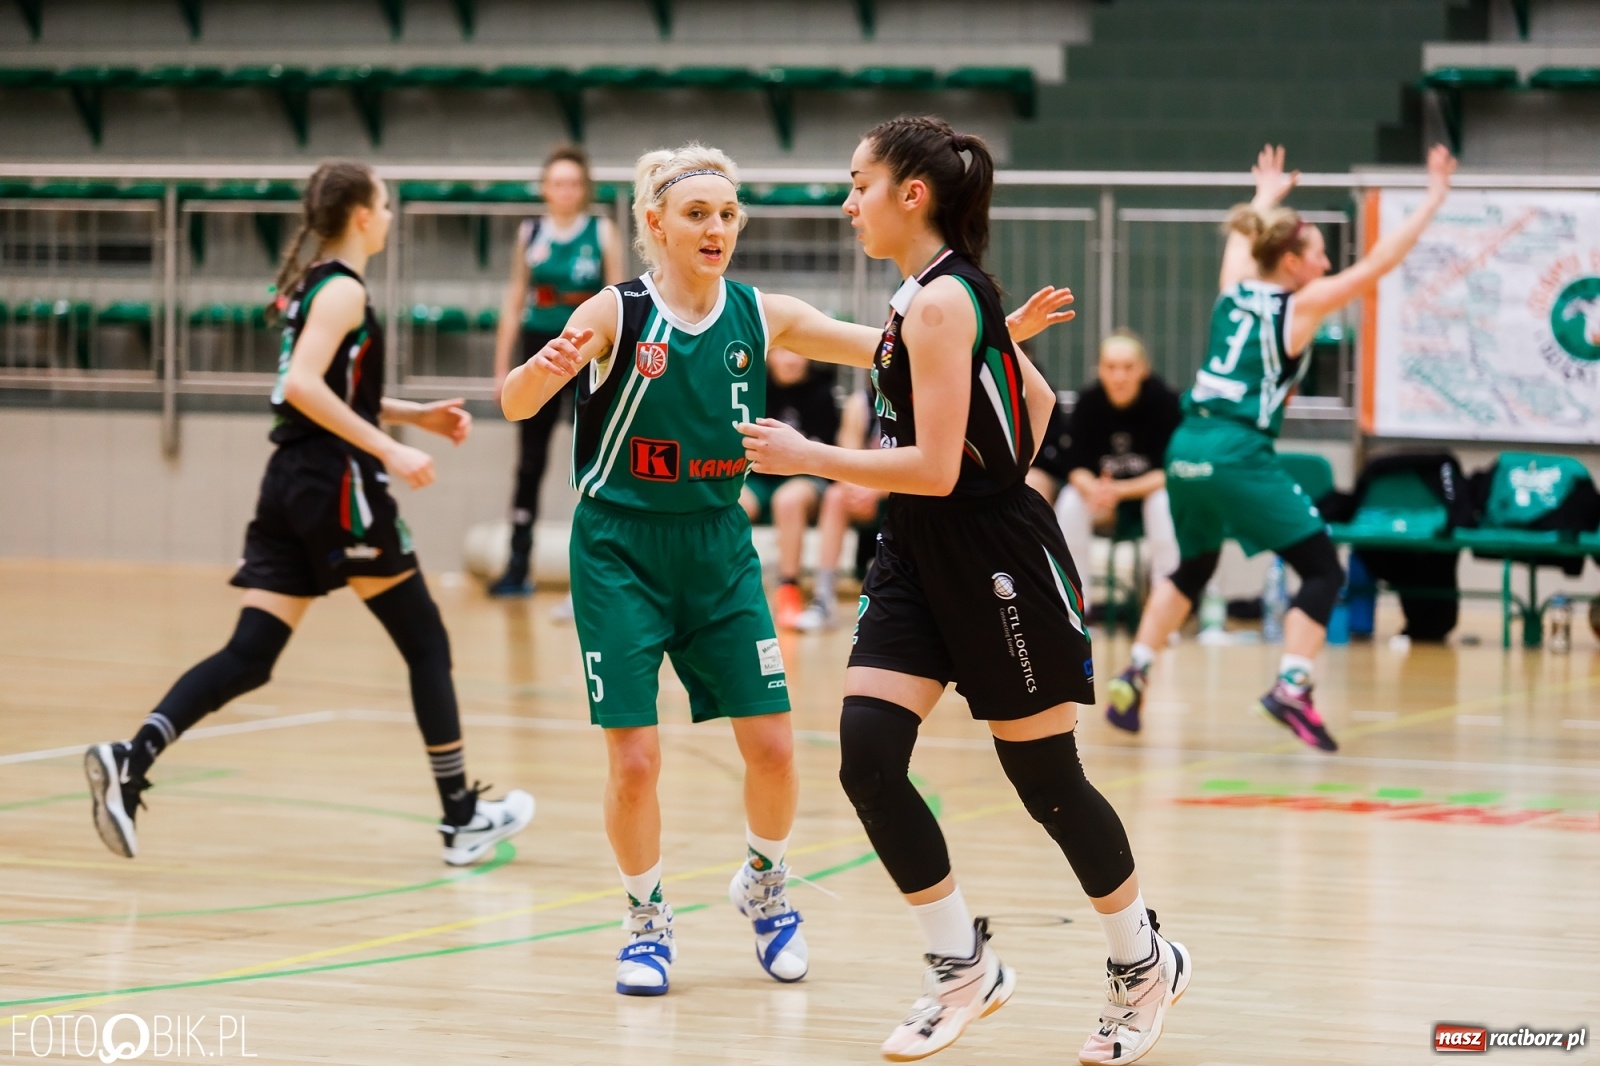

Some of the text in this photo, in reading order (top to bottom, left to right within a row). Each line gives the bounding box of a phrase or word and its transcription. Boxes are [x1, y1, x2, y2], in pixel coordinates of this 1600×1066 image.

[1209, 308, 1255, 375] 3
[731, 382, 751, 431] 5
[634, 442, 674, 477] K
[1007, 605, 1038, 694] CTL LOGISTICS
[586, 651, 604, 703] 5
